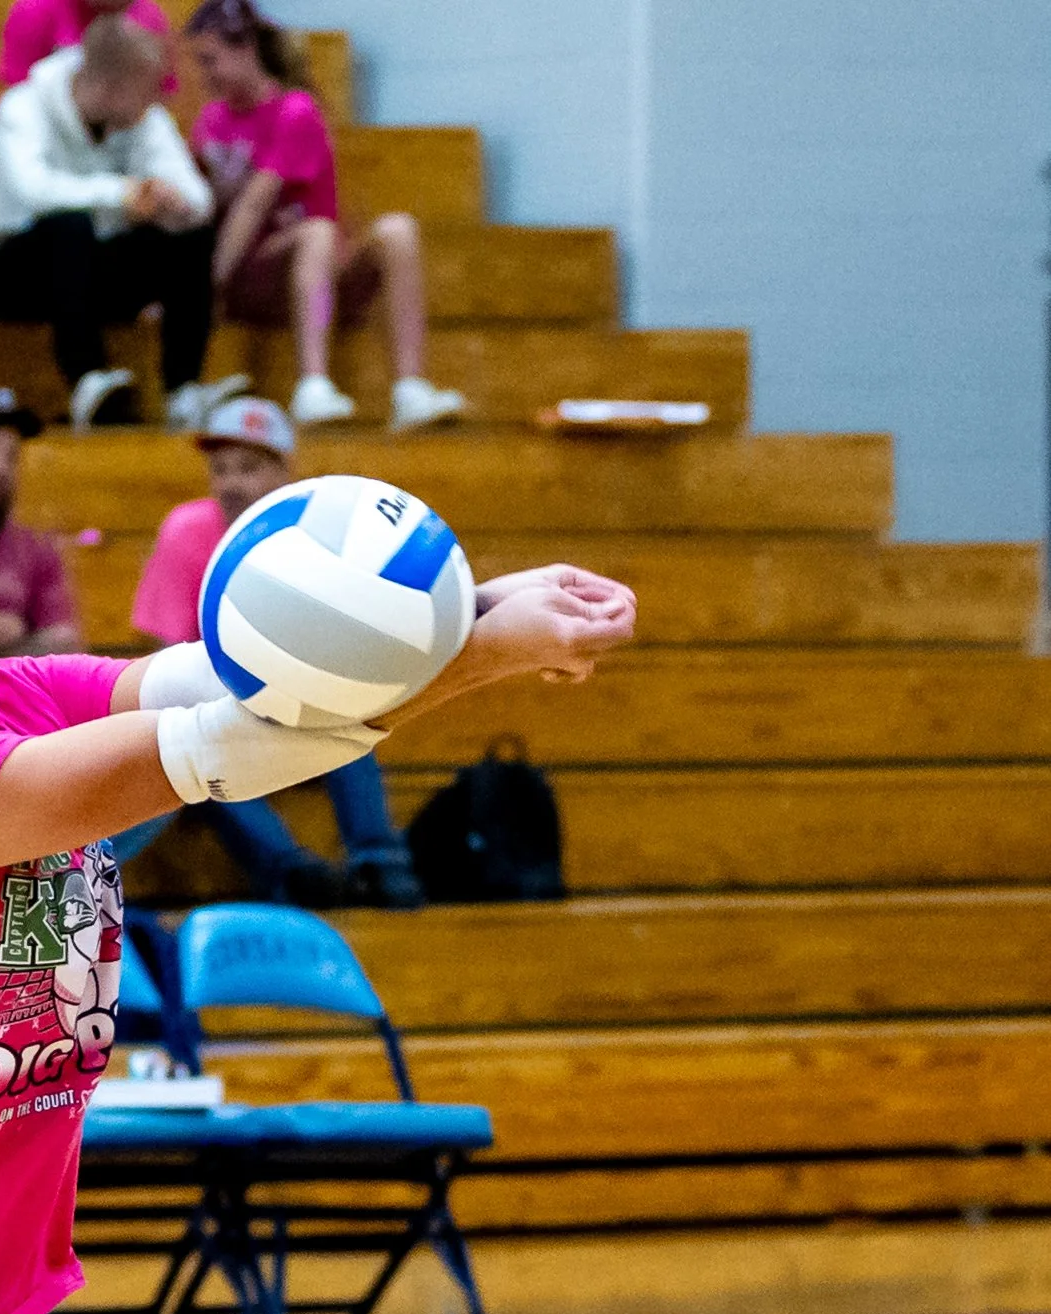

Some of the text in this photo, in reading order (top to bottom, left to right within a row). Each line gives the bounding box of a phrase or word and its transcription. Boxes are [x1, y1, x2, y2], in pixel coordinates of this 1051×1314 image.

[9, 884, 28, 956] CAPTAINS
[0, 1107, 14, 1122] ON
[16, 1100, 32, 1117] THE
[34, 1089, 80, 1112] COURT.
